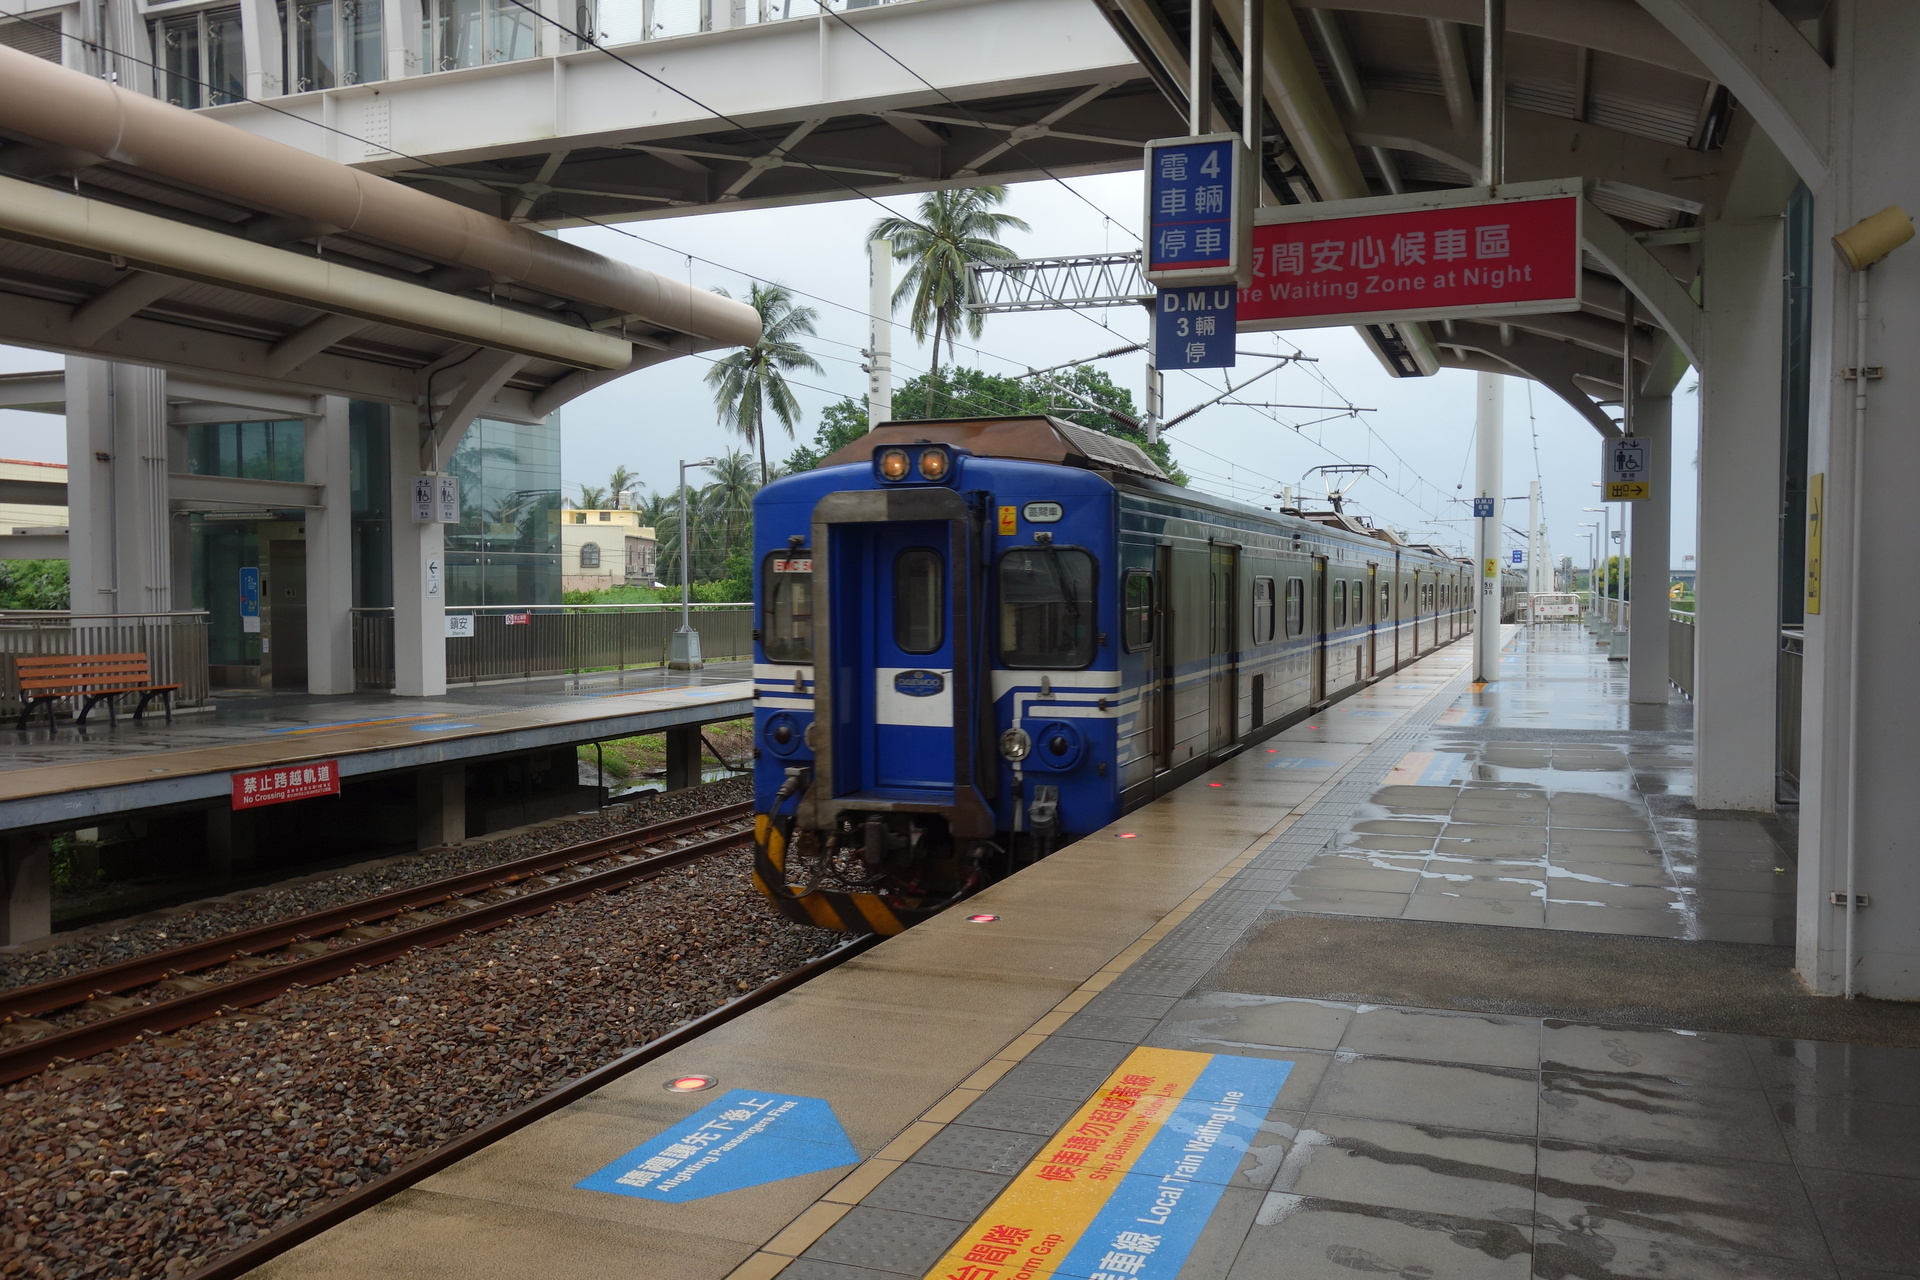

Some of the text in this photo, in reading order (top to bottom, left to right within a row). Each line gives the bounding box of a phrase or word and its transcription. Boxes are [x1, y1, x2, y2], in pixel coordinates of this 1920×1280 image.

[1269, 279, 1358, 300] Waiting
[1365, 273, 1426, 294] Zone
[1433, 270, 1456, 288] at
[1463, 264, 1533, 288] Night
[1164, 290, 1230, 313] D.M.U
[1185, 342, 1206, 363] 停
[1612, 484, 1630, 497] 出口
[243, 766, 330, 794] 禁止跨越軌道
[243, 795, 254, 804] No
[254, 790, 285, 801] Crossing
[1210, 1091, 1244, 1113] Line
[1035, 1074, 1157, 1182] 候車請勿超越黃線
[1089, 1083, 1178, 1181] Stay Behind the Yellow Line
[1183, 1113, 1236, 1152] Waiting
[615, 1098, 774, 1188] 請禮讓先下後上
[656, 1100, 799, 1192] Alighting Passengers First
[1162, 1154, 1205, 1183] Train
[1137, 1185, 1184, 1225] Local
[1030, 1234, 1065, 1256] Gap
